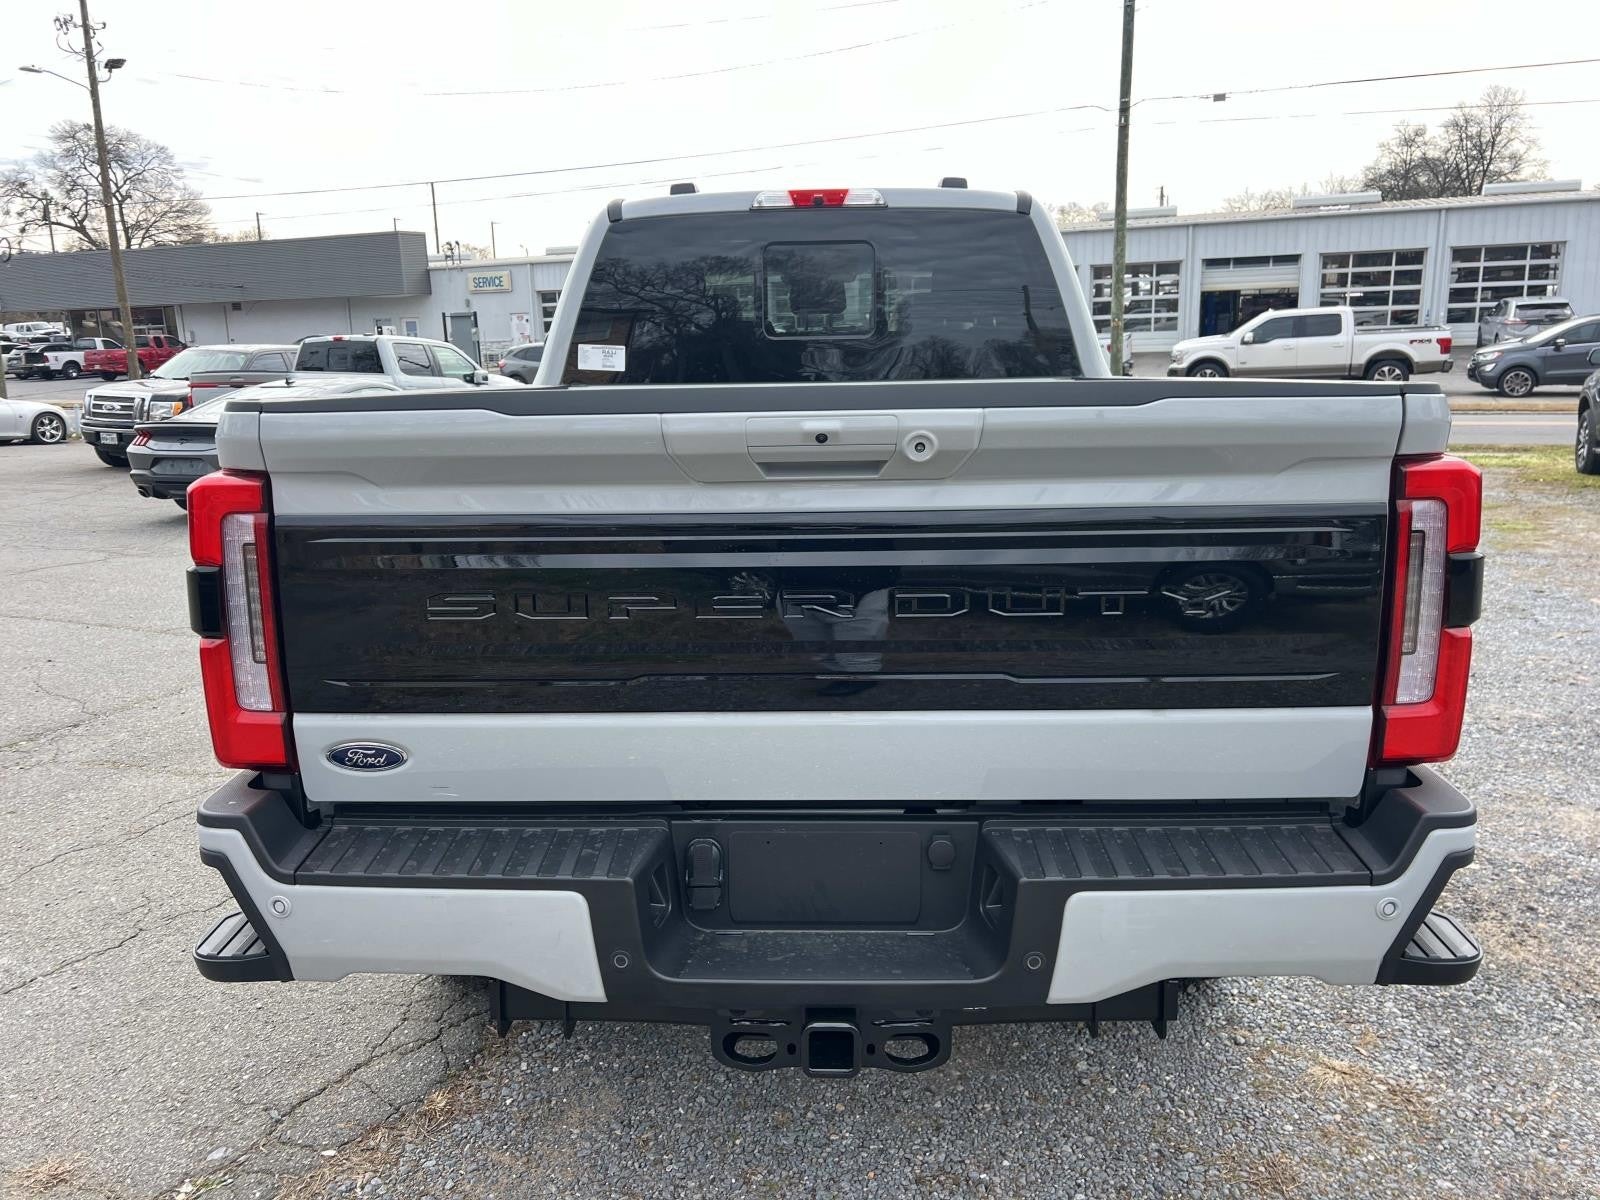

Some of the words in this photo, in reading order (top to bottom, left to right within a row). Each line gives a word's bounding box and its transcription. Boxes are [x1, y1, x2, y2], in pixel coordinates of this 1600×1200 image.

[472, 276, 504, 288] SERVICE
[426, 592, 855, 620] SUPER
[893, 587, 1232, 616] DUTY
[345, 749, 387, 766] Ford
